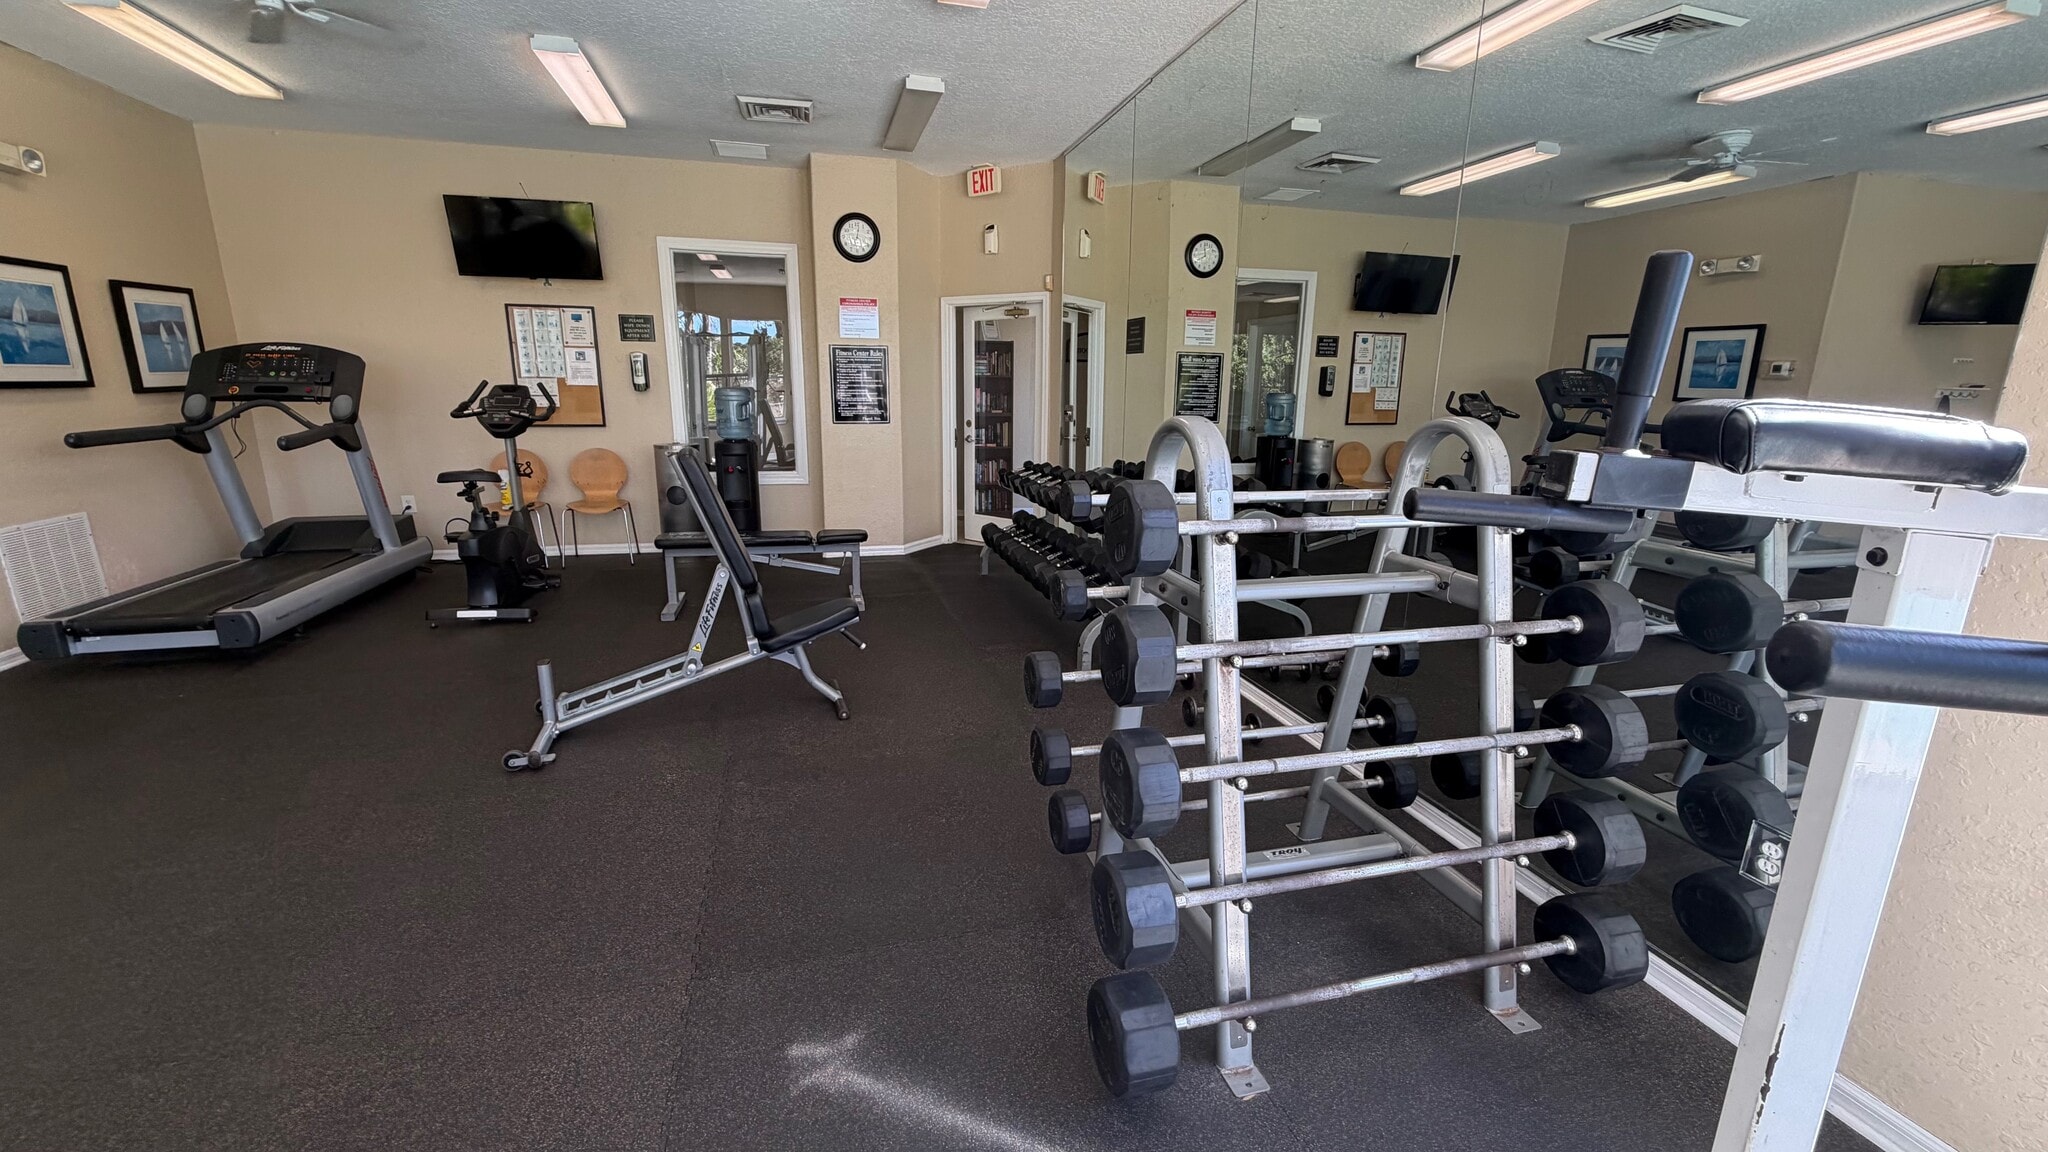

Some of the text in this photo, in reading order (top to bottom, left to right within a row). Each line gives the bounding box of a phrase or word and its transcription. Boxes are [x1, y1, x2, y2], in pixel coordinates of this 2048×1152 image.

[972, 168, 994, 194] EXIT
[870, 349, 884, 357] Rules
[1270, 847, 1302, 856] TROY
